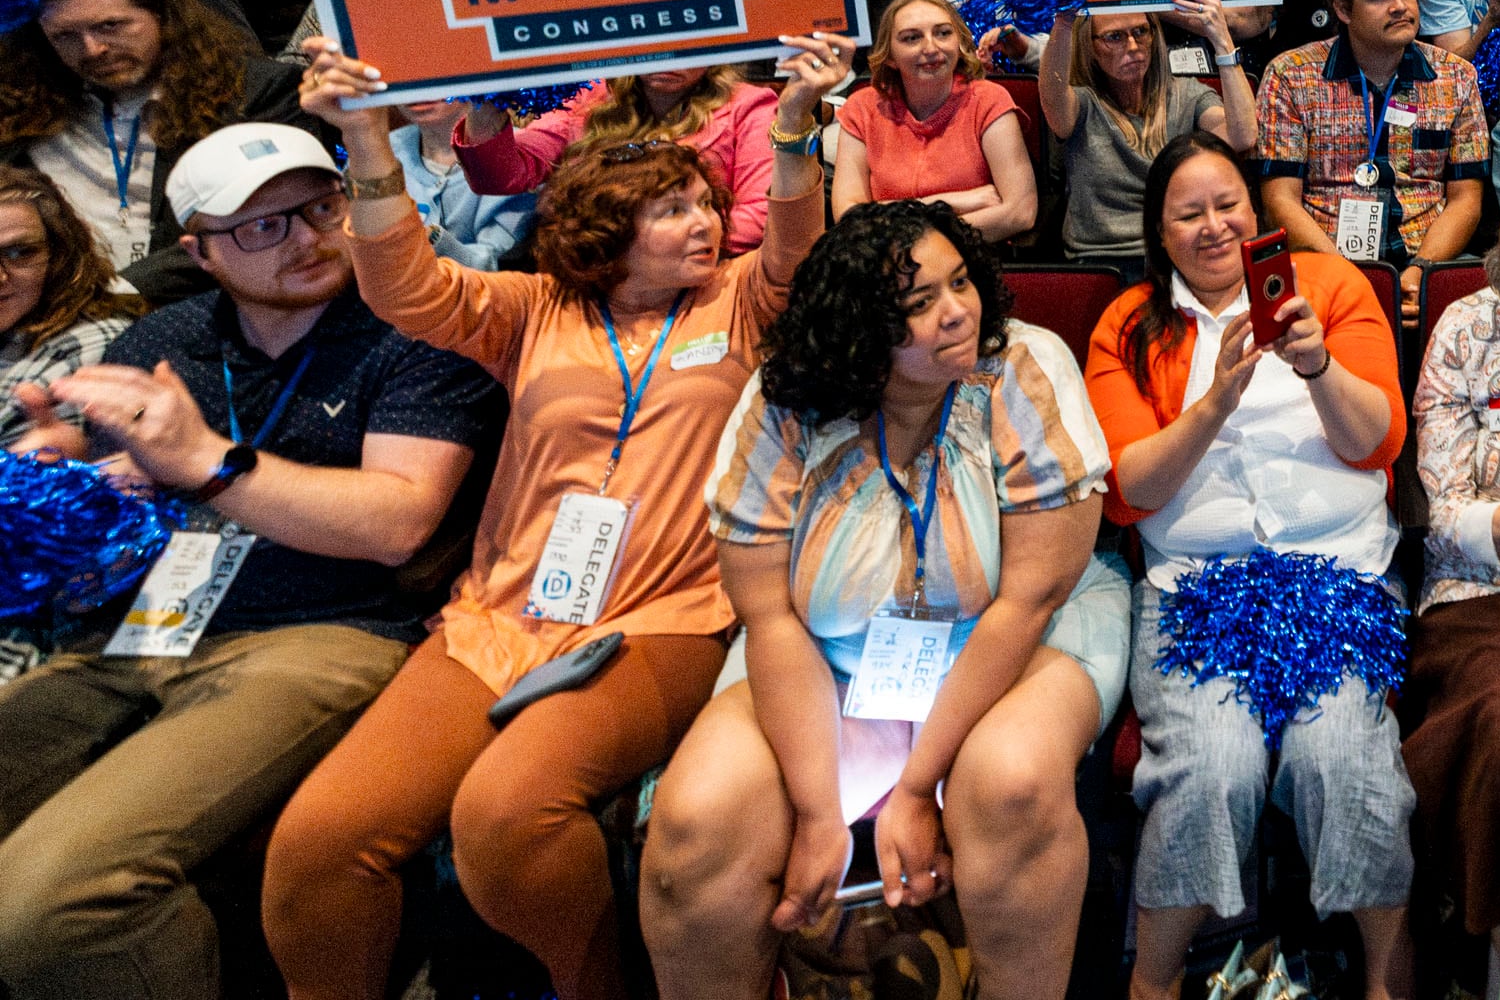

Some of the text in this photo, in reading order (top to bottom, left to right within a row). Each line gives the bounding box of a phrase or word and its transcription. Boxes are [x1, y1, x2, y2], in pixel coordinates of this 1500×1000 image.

[513, 5, 724, 43] CONGRESS
[1366, 205, 1379, 260] DELEGAT
[569, 522, 613, 625] DELEGATE
